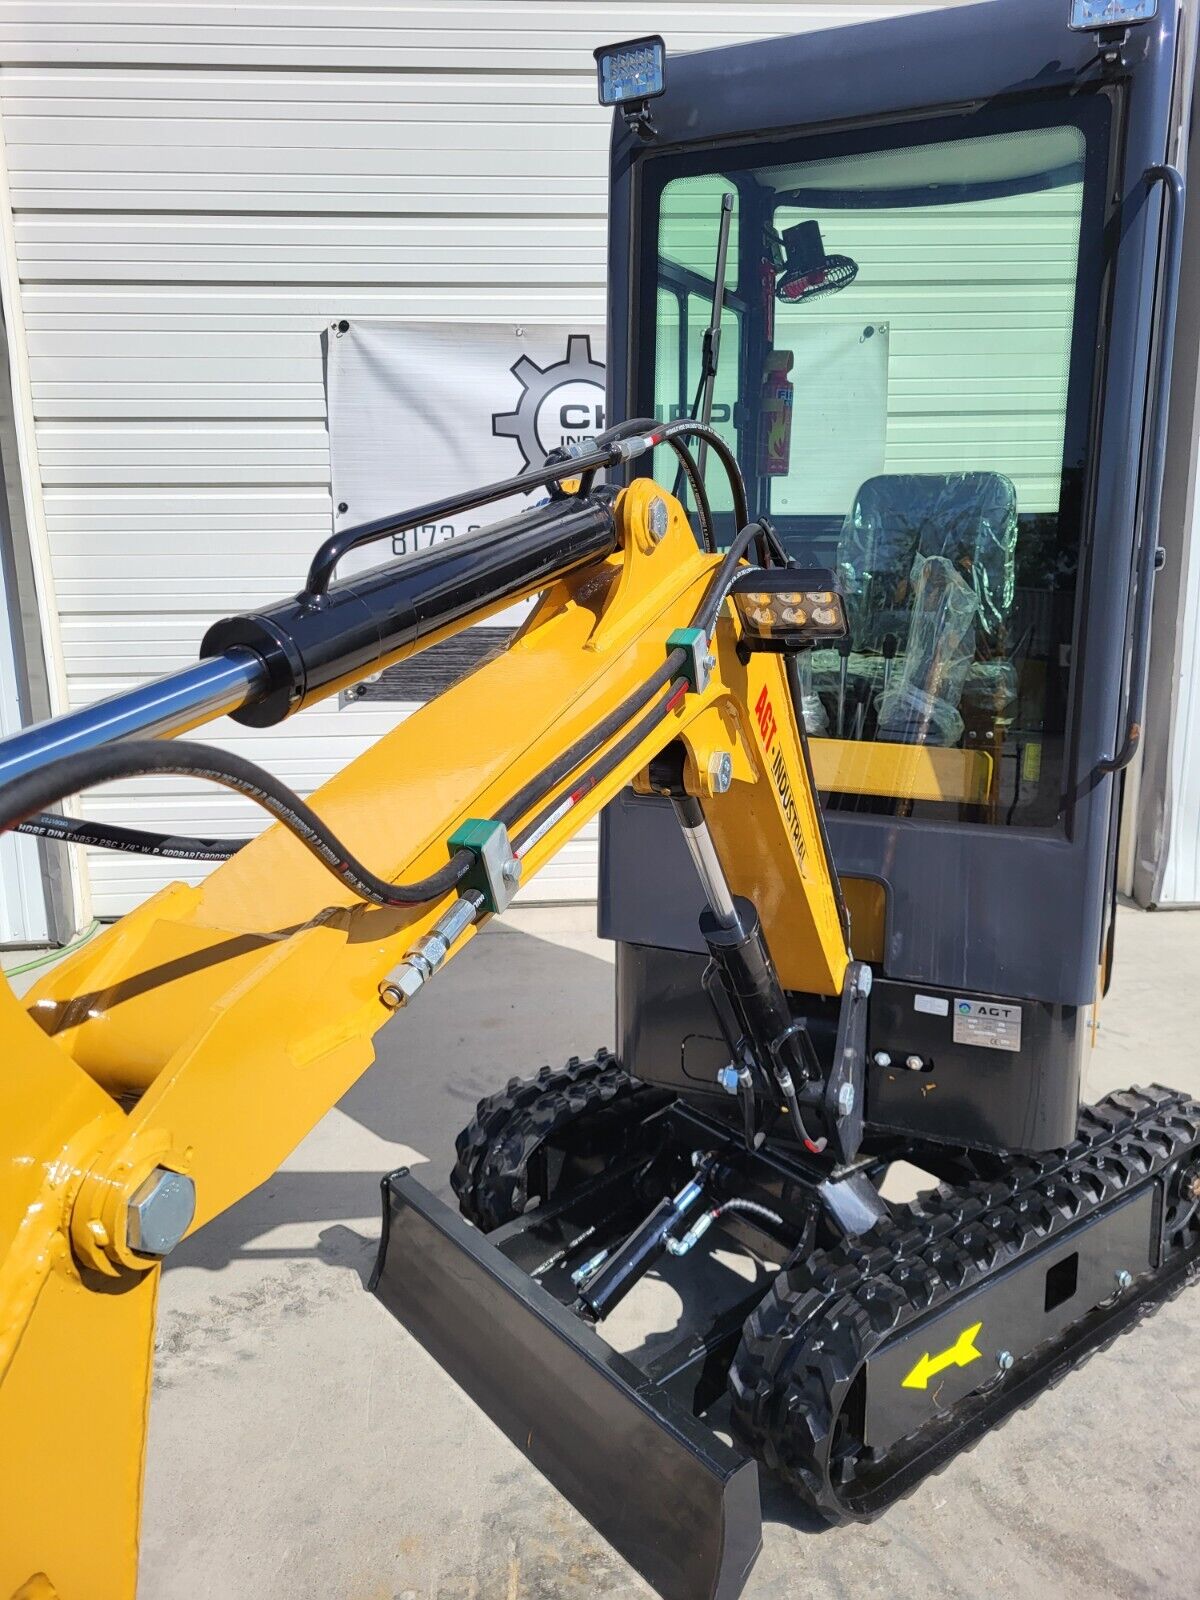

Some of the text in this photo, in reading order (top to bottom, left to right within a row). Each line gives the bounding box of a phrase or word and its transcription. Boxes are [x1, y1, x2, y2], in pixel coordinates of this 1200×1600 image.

[755, 684, 807, 880] AGT INDUSTRIAL
[18, 823, 46, 836] HOSE
[46, 829, 65, 839] DIN
[66, 832, 98, 844] EN857
[98, 839, 118, 849] 2SC
[977, 1006, 1012, 1018] AGT
